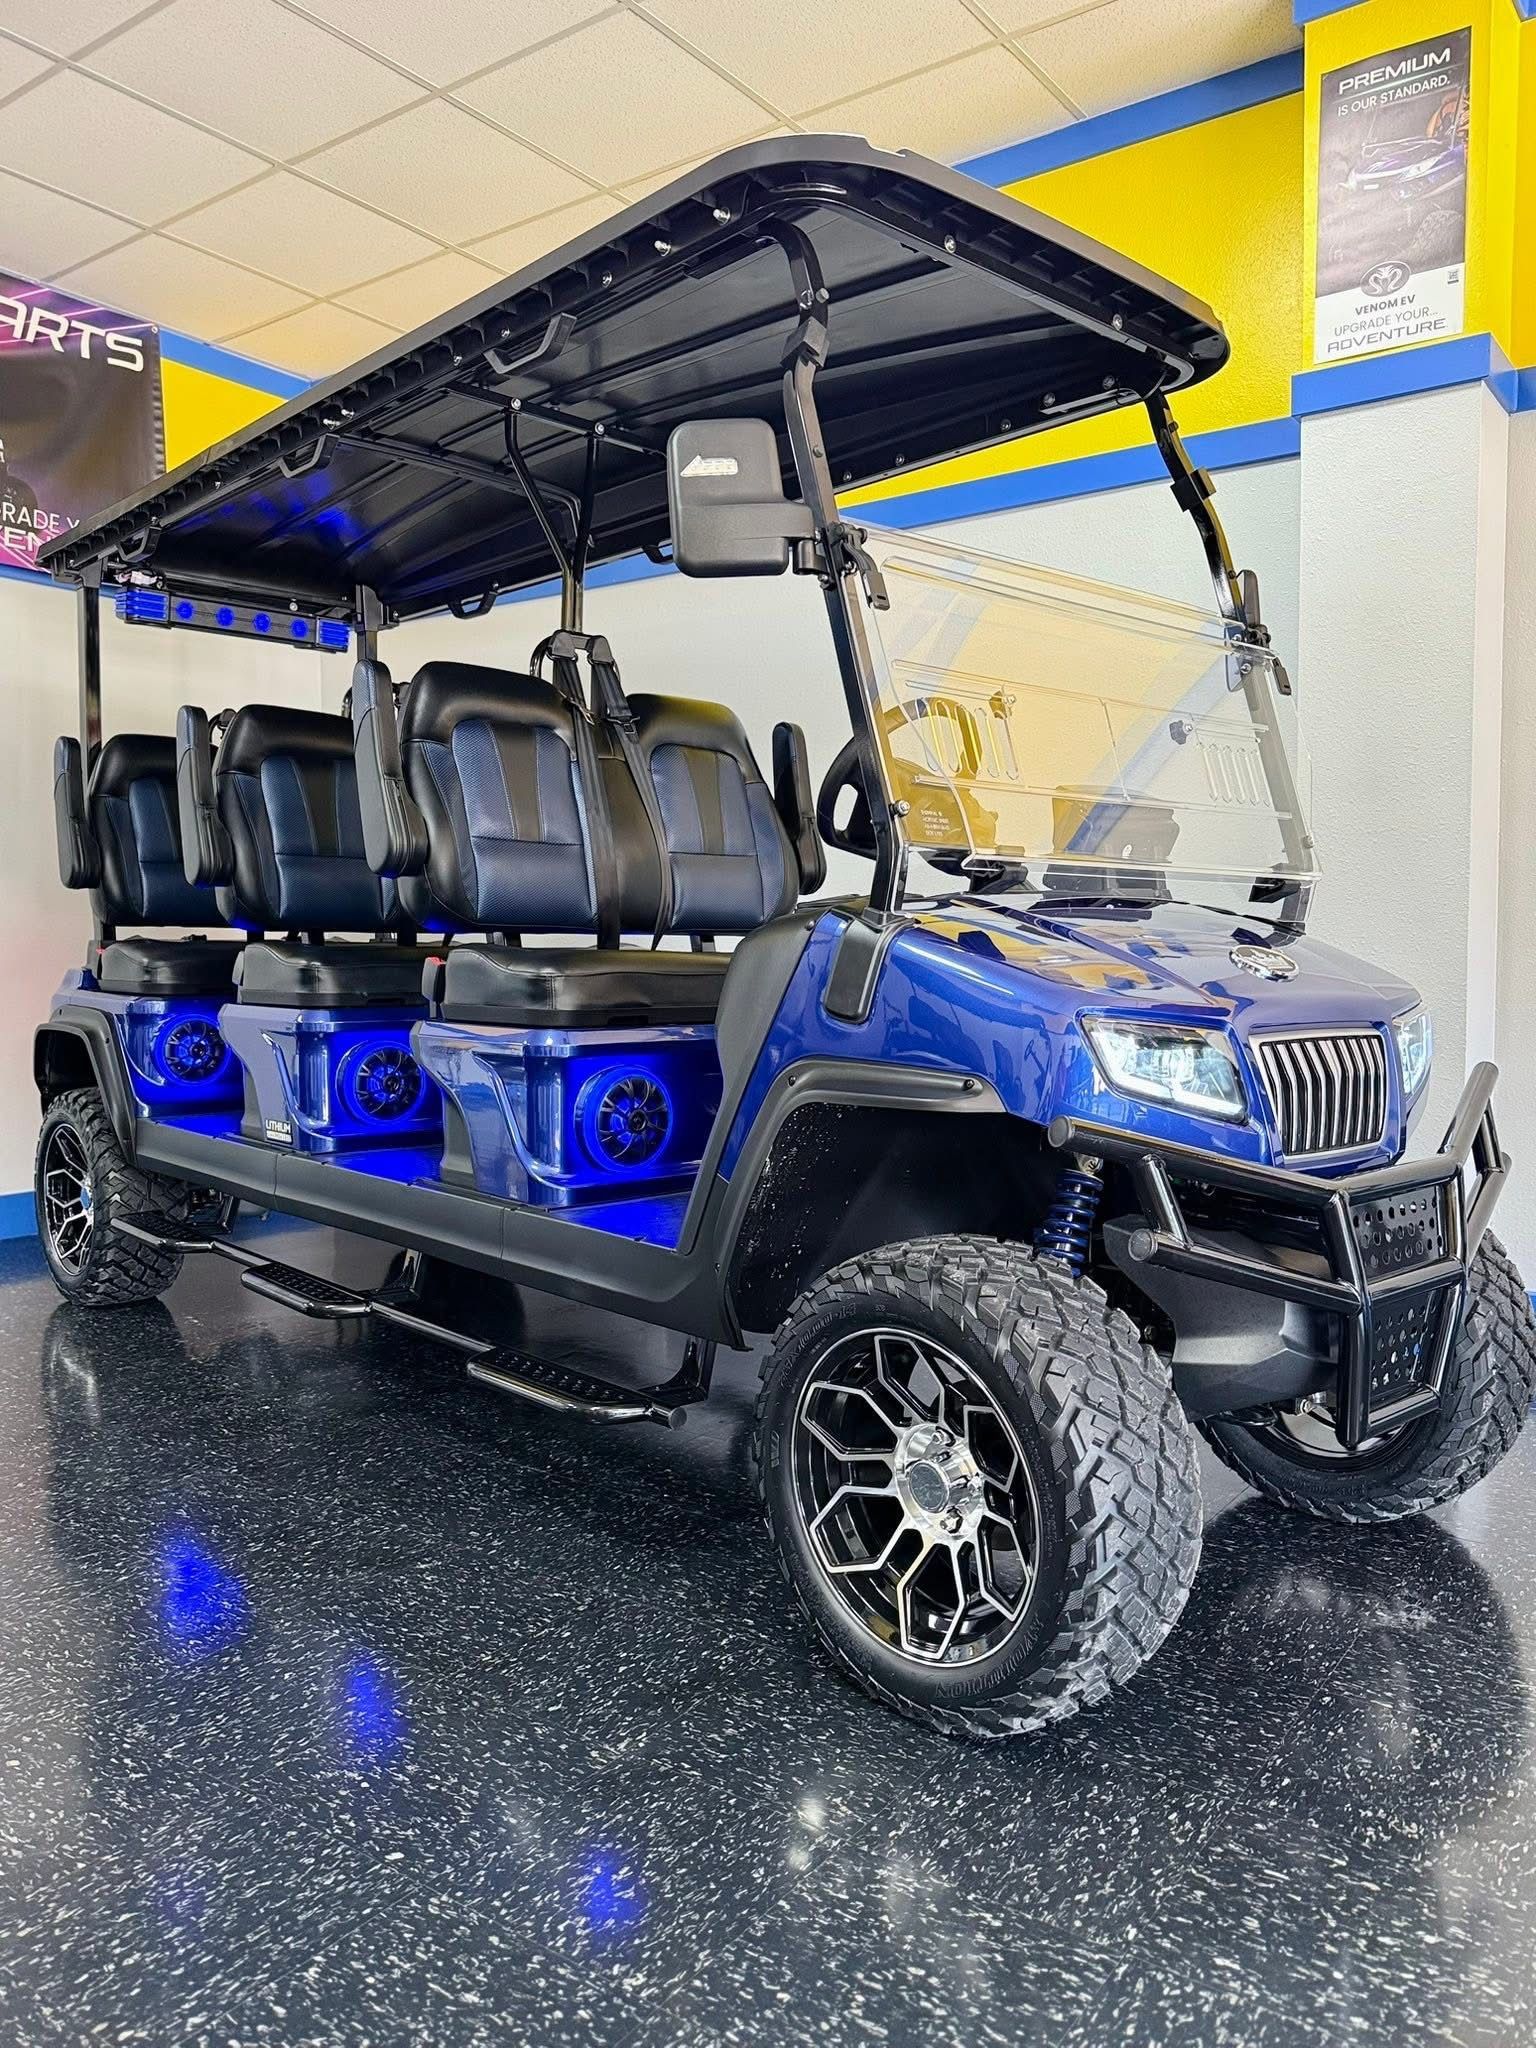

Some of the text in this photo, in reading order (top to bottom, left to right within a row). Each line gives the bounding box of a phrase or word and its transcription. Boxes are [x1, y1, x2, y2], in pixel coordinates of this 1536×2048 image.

[1338, 47, 1451, 95] PREMIUM
[1337, 74, 1450, 117] IS OUR STANDARD.
[1334, 306, 1438, 337] UPGRADE YOUR...
[1355, 294, 1416, 316] VENOM EV
[1327, 318, 1446, 353] ADVENTURE
[0, 501, 60, 534] RADE
